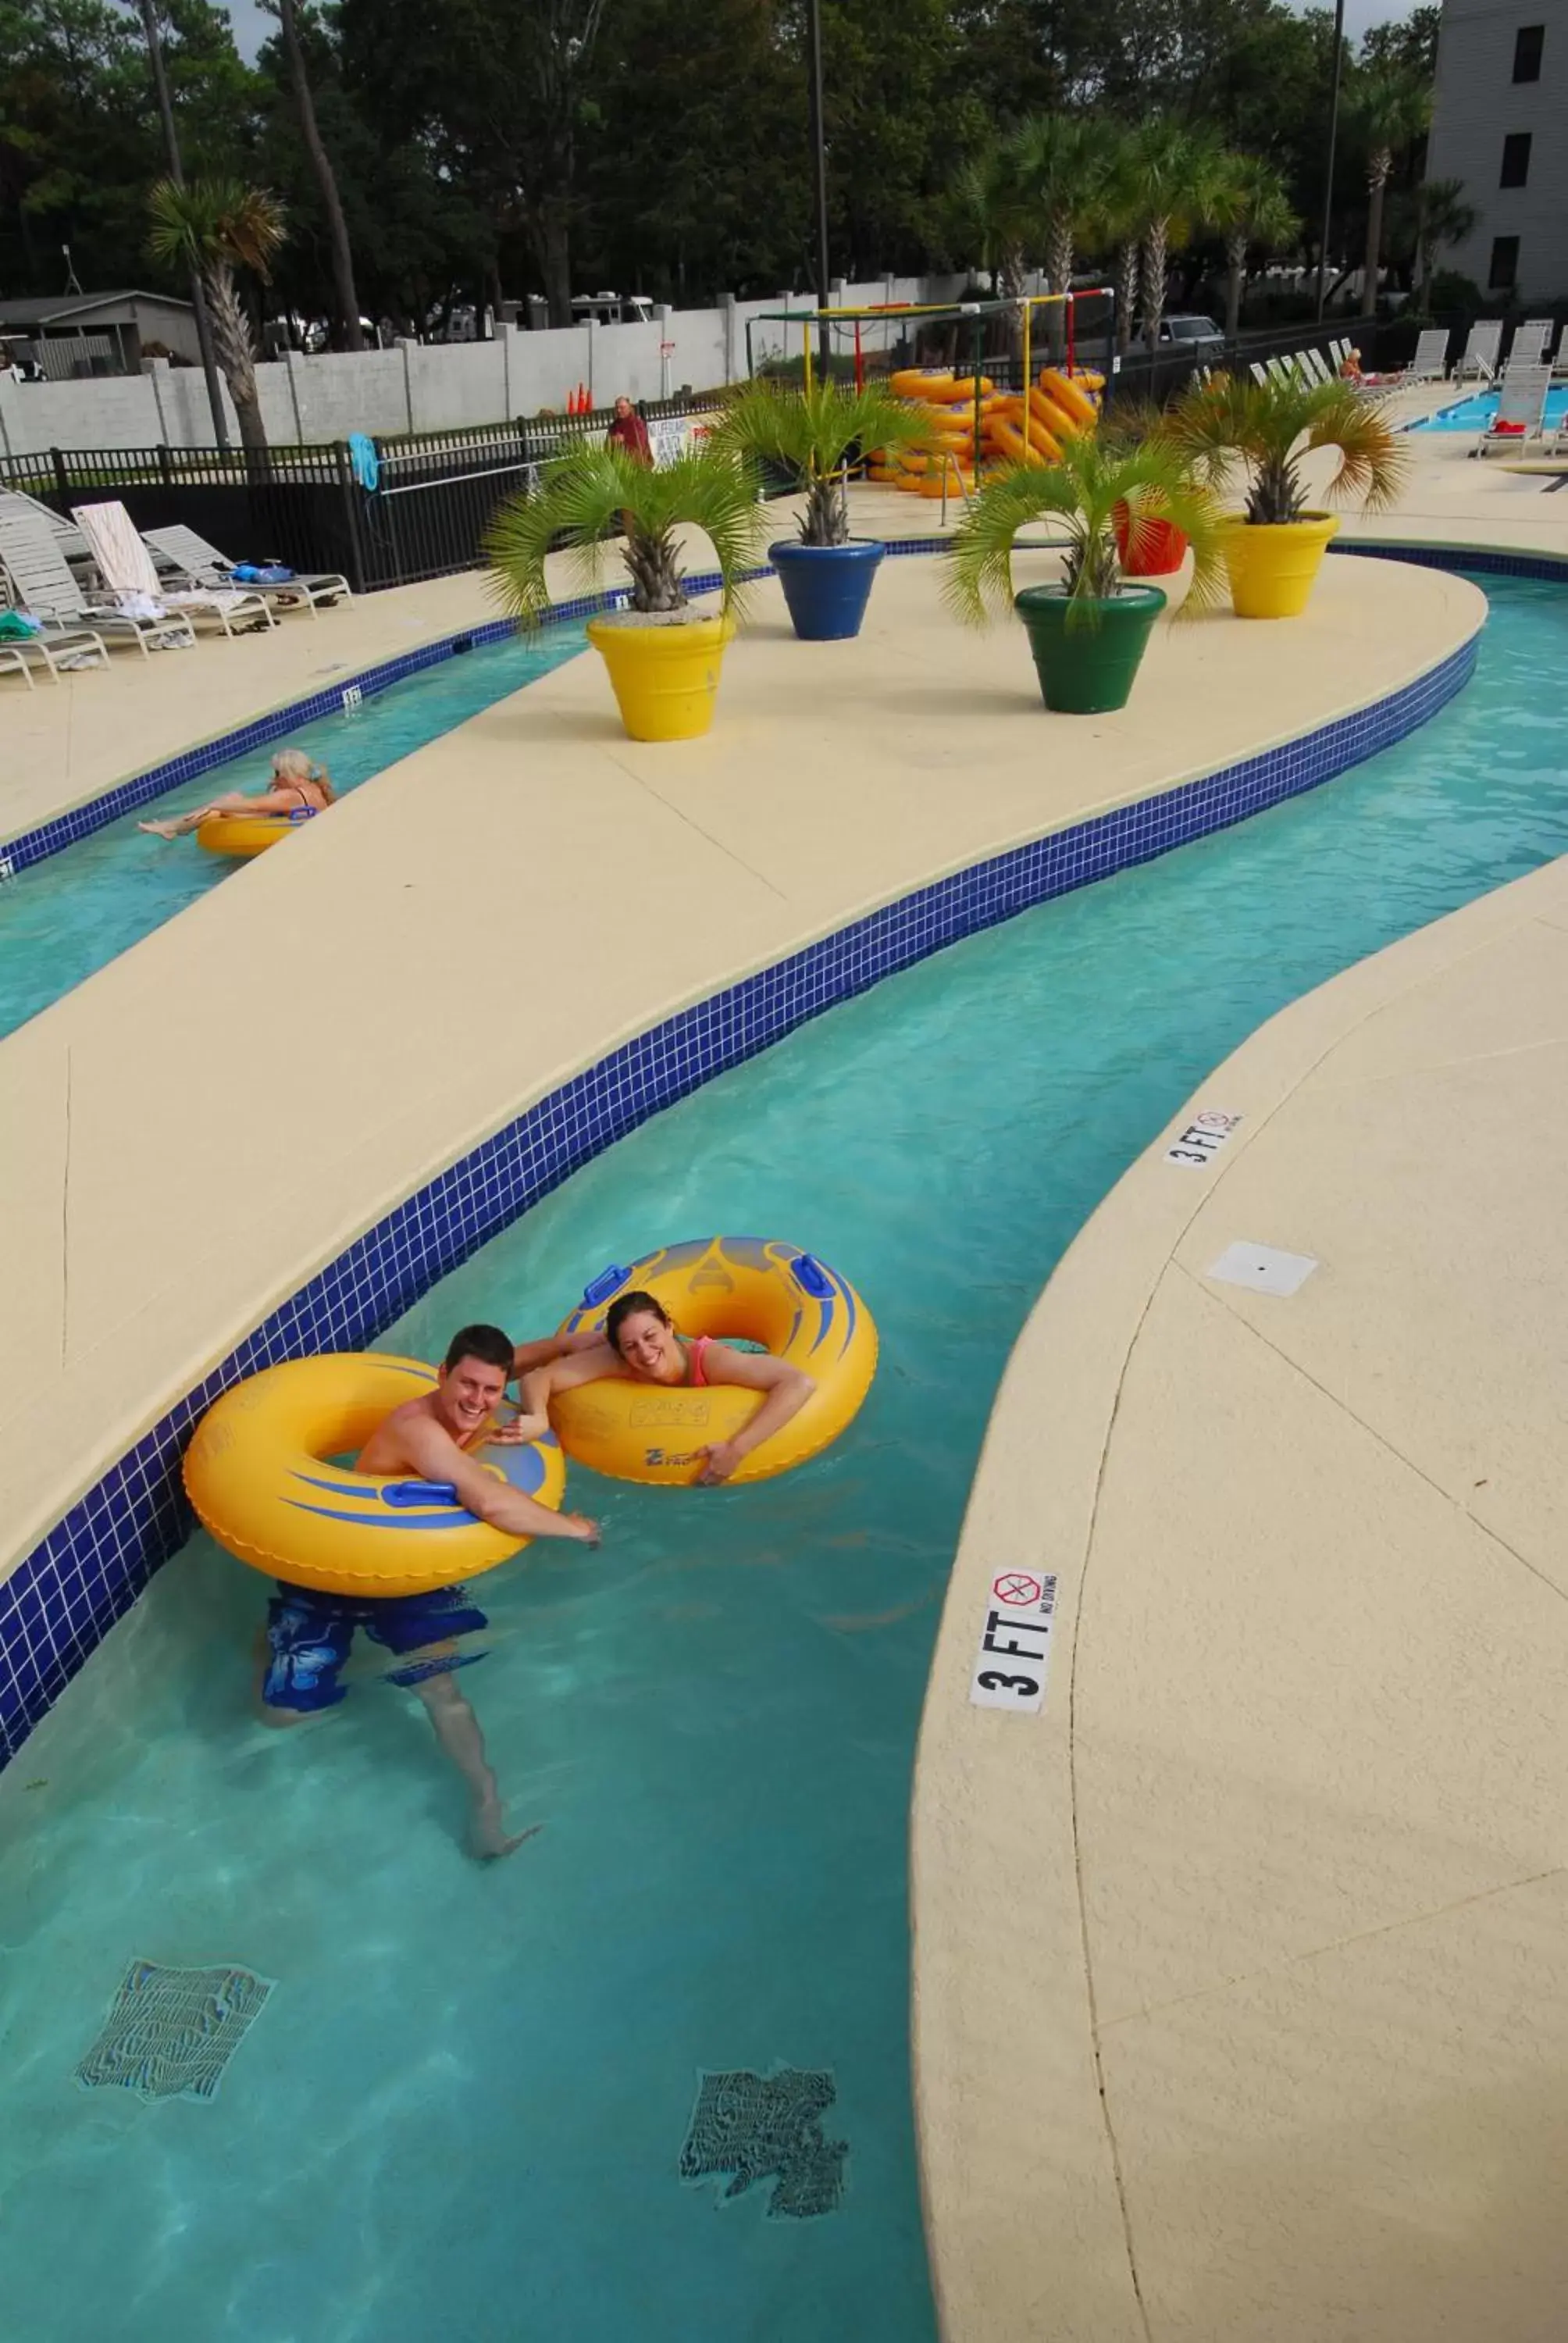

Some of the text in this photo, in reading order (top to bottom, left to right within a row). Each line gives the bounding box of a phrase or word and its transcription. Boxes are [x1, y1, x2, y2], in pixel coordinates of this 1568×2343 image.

[1169, 1126, 1225, 1162] 3 FT
[1039, 1575, 1057, 1614] NO DIVING
[978, 1610, 1048, 1696] 3 FT
